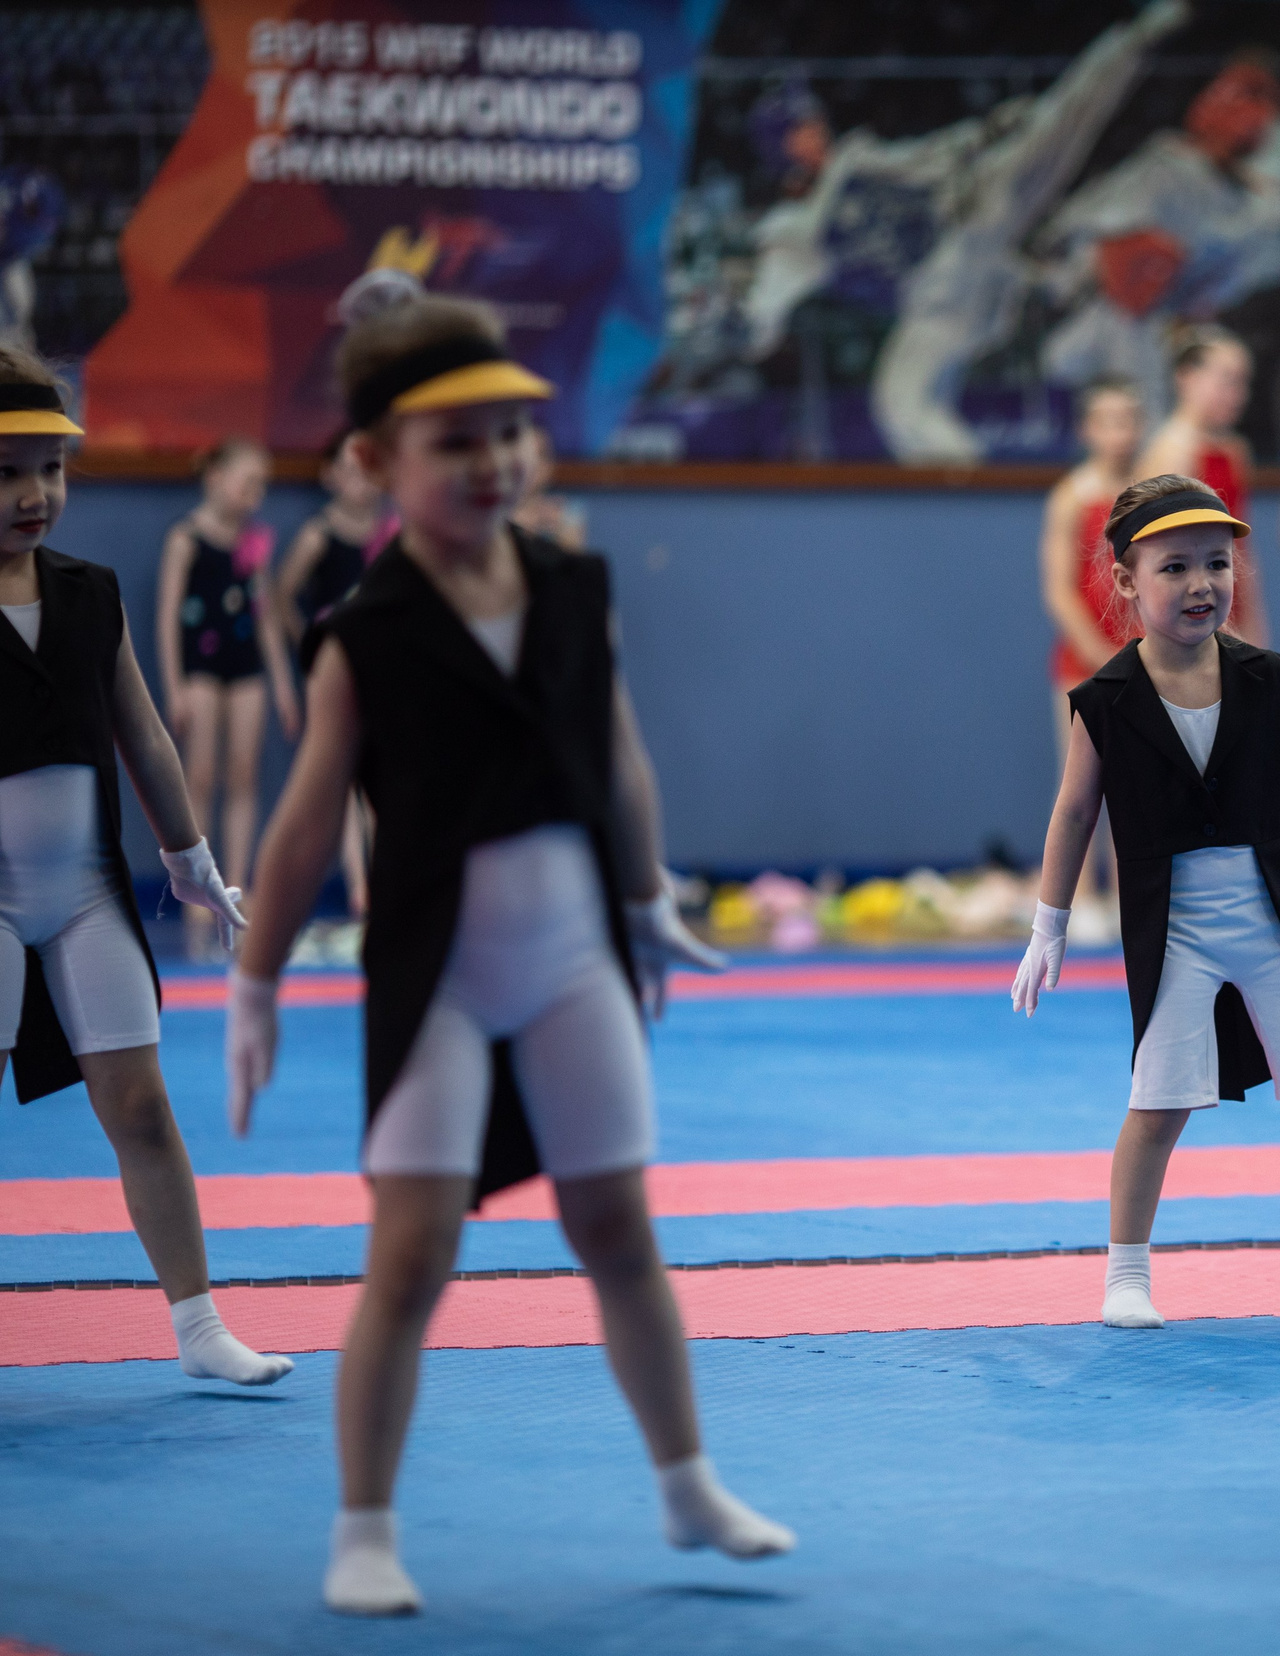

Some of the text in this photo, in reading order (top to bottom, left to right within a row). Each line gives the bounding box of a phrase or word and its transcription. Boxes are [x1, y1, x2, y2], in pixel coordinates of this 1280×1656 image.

[250, 20, 641, 75] 2015 WTF WORLD
[247, 70, 642, 138] TAEKWONDO
[247, 135, 641, 191] CHAMPIONSHIPS
